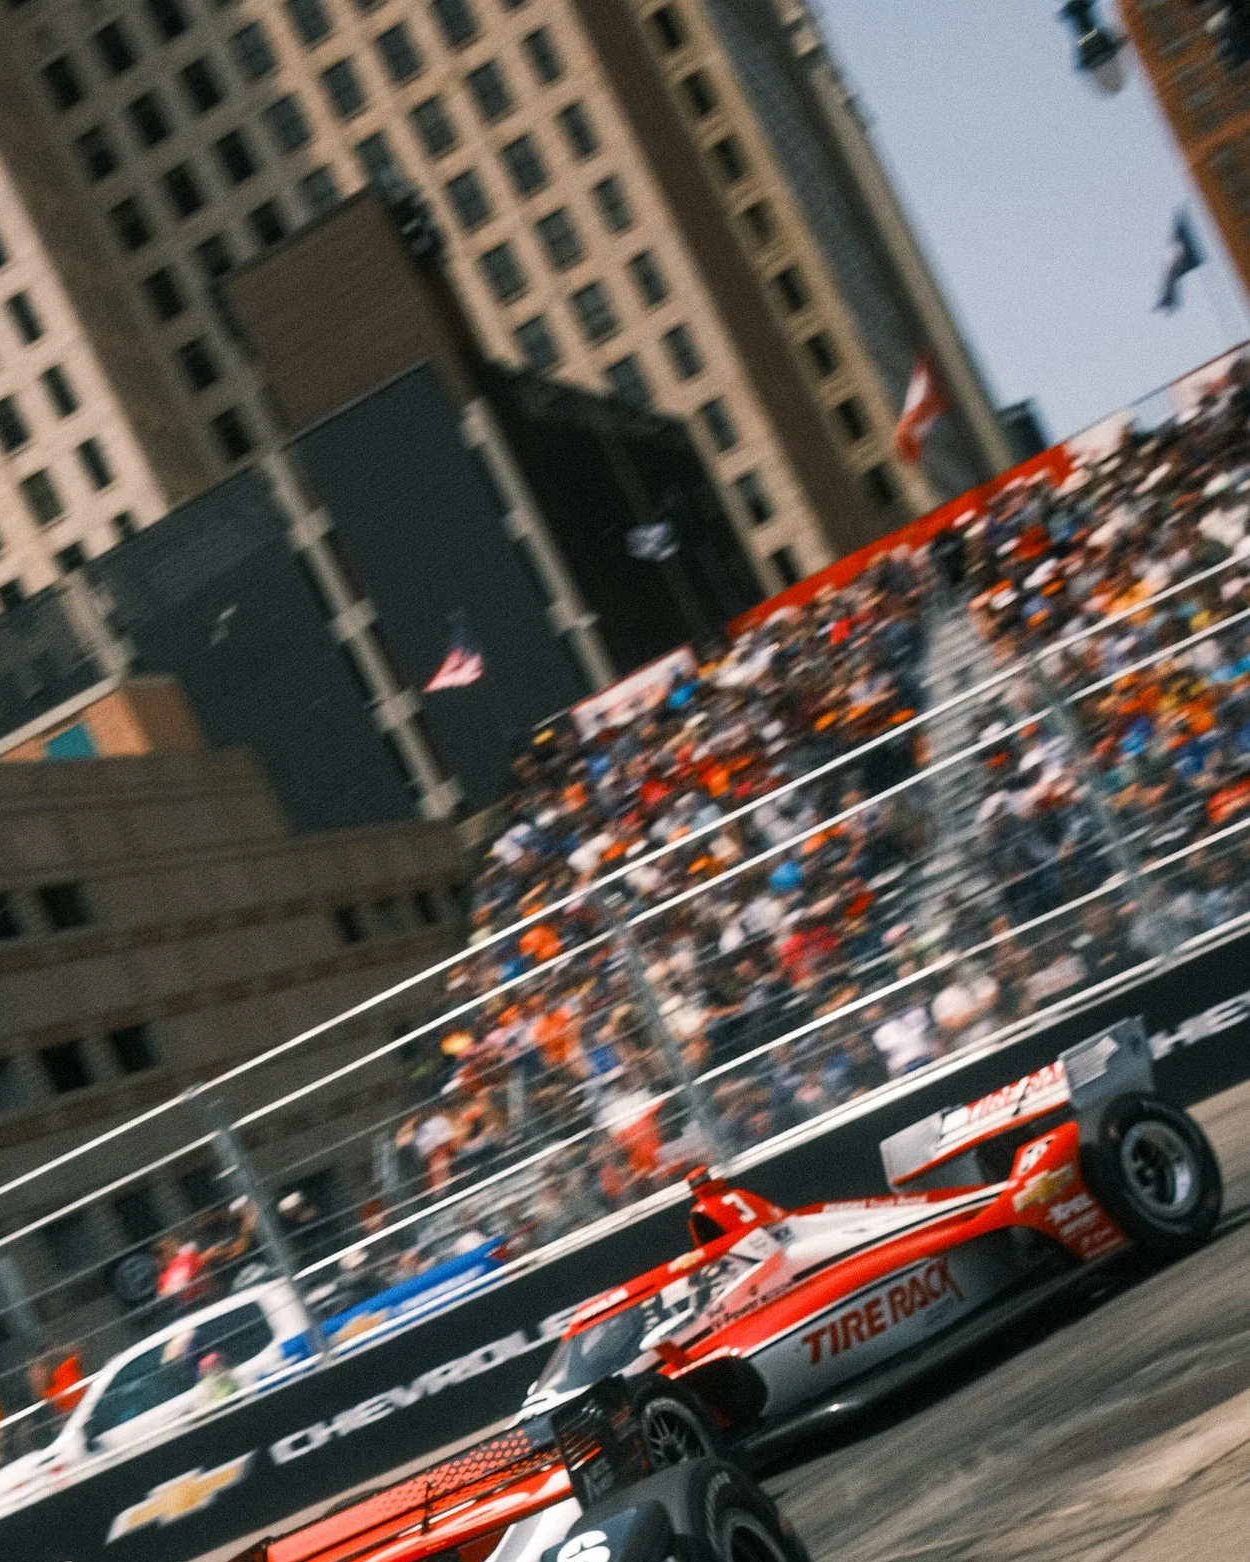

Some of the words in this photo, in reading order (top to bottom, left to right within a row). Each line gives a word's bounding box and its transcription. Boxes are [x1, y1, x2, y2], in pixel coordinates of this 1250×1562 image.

[720, 1192, 757, 1222] 3
[802, 1297, 887, 1366] TIRE
[887, 1256, 966, 1325] RACK
